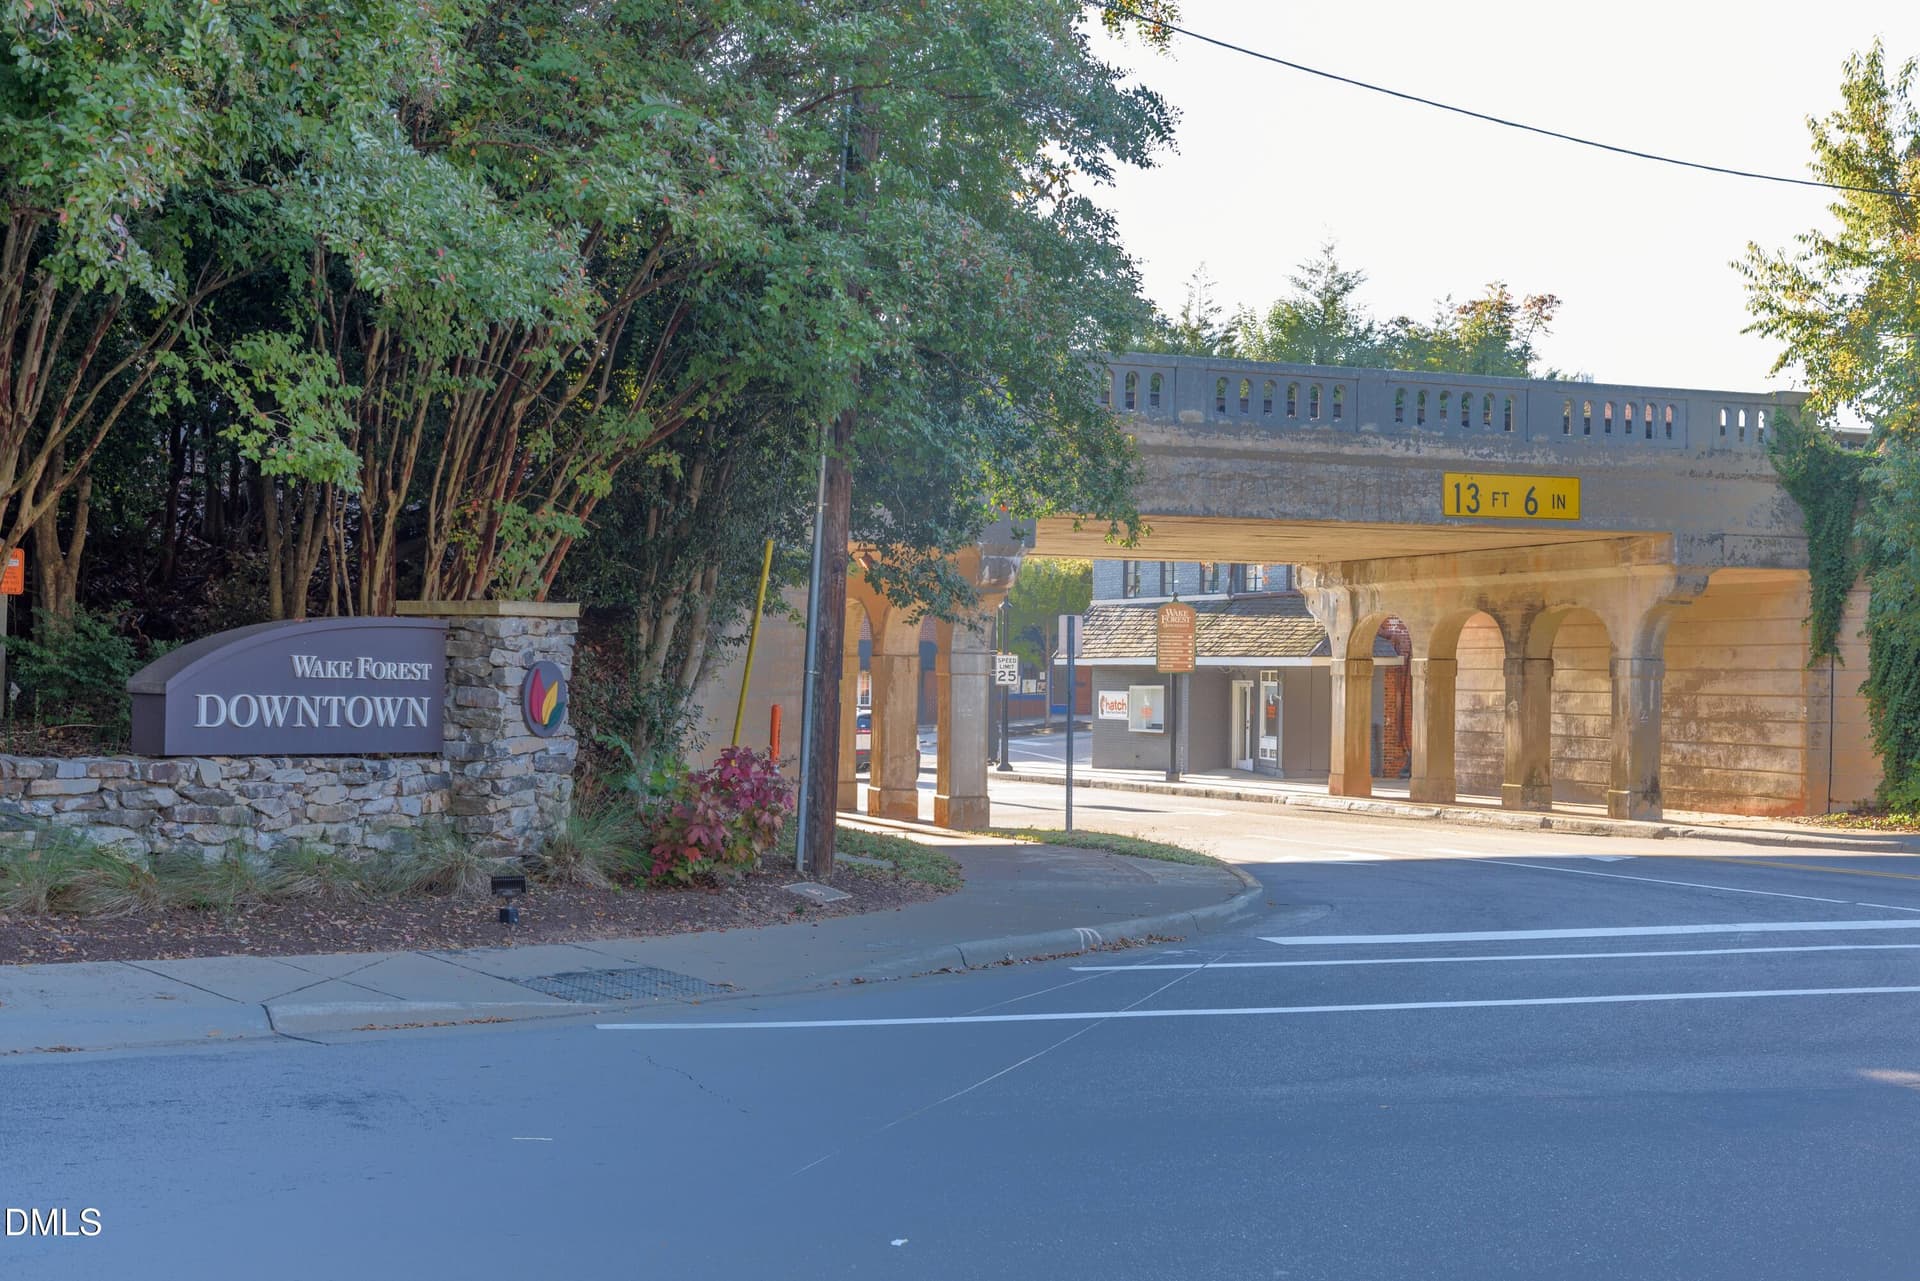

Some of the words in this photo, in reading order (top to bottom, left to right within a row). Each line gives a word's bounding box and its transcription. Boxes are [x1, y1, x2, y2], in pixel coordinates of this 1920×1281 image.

[1454, 482, 1481, 514] 13
[1491, 491, 1510, 508] FT
[1524, 485, 1539, 516] 6
[1552, 494, 1566, 510] IN
[1161, 615, 1191, 624] FOREST
[1165, 608, 1188, 617] WAKE
[290, 655, 353, 679] WAKE
[356, 656, 433, 681] FOREST
[997, 670, 1017, 682] 25
[194, 694, 432, 728] DOWNTOWN
[1105, 697, 1127, 711] hatch
